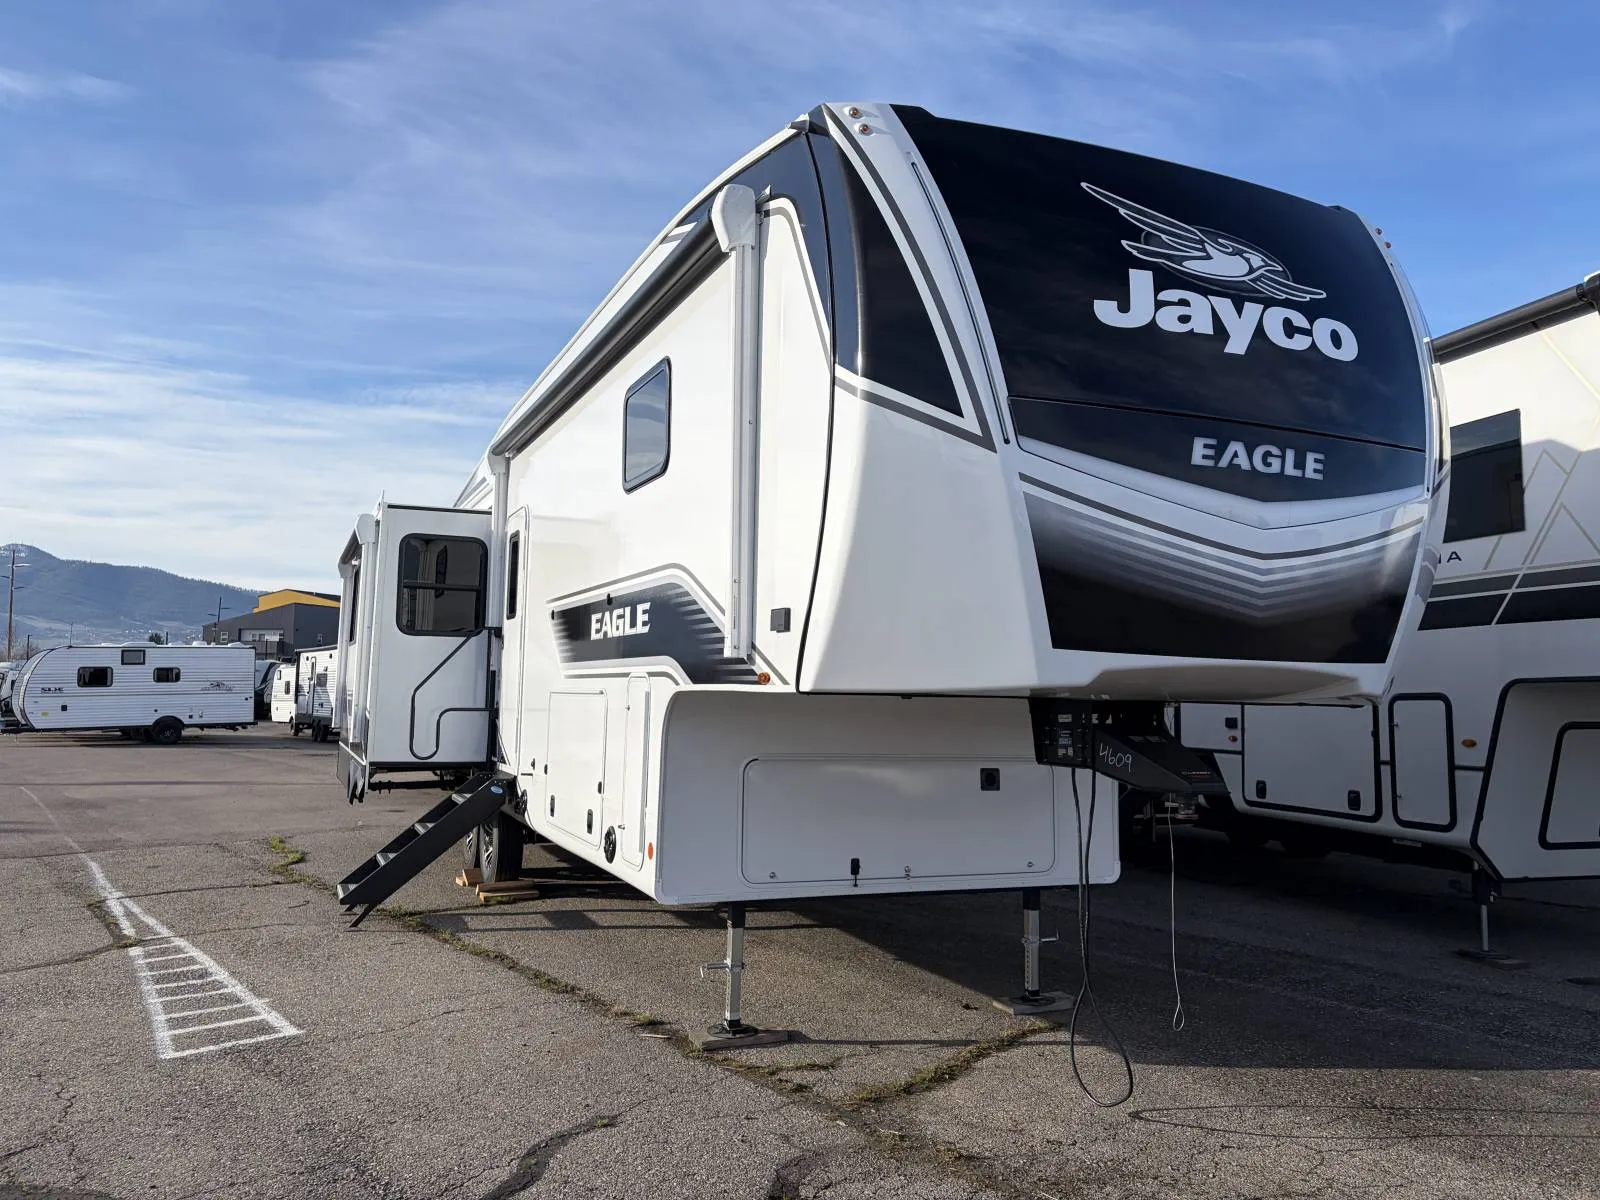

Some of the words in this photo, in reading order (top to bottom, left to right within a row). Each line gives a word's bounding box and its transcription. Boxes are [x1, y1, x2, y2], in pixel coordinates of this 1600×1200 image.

[1093, 268, 1359, 362] Jayco
[1190, 436, 1326, 481] EAGLE
[590, 601, 651, 641] EAGLE
[1099, 743, 1132, 773] 4609
